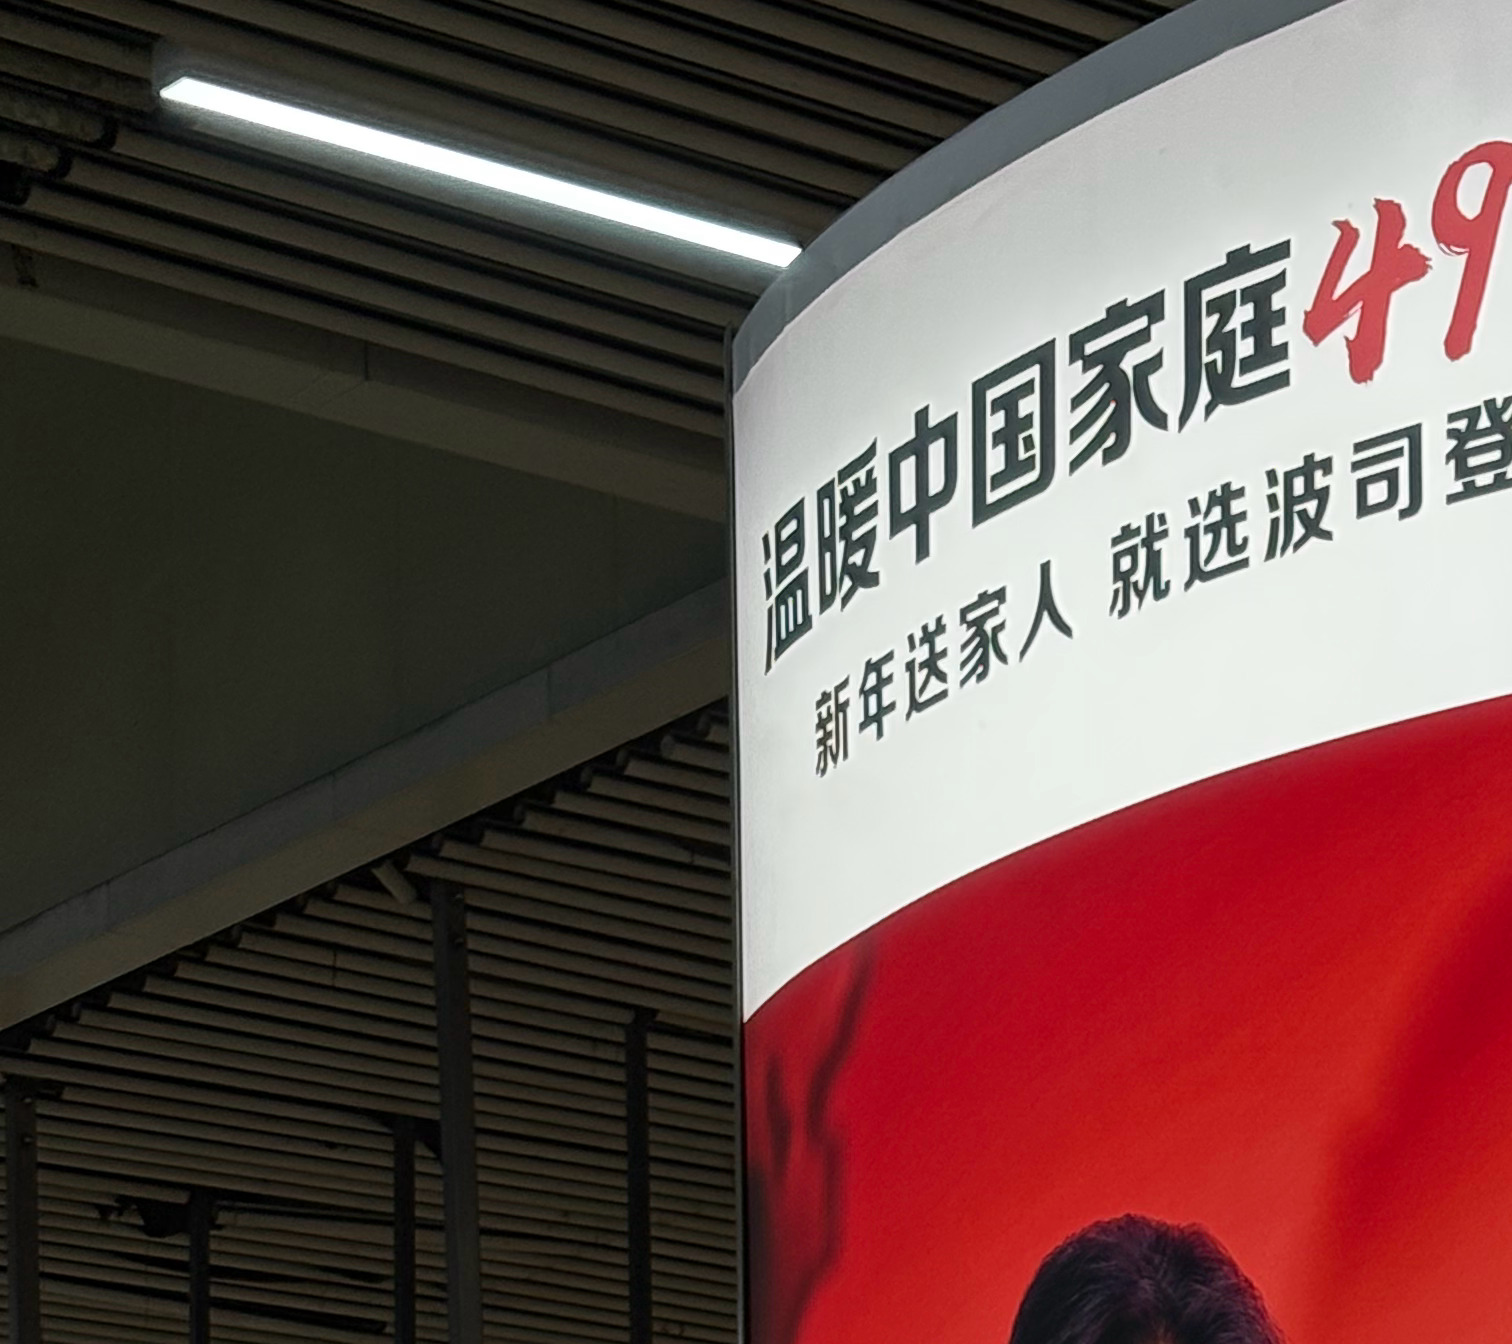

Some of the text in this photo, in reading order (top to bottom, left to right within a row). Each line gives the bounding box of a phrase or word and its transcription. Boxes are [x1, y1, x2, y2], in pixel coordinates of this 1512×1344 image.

[815, 559, 1073, 778] 新年送家人
